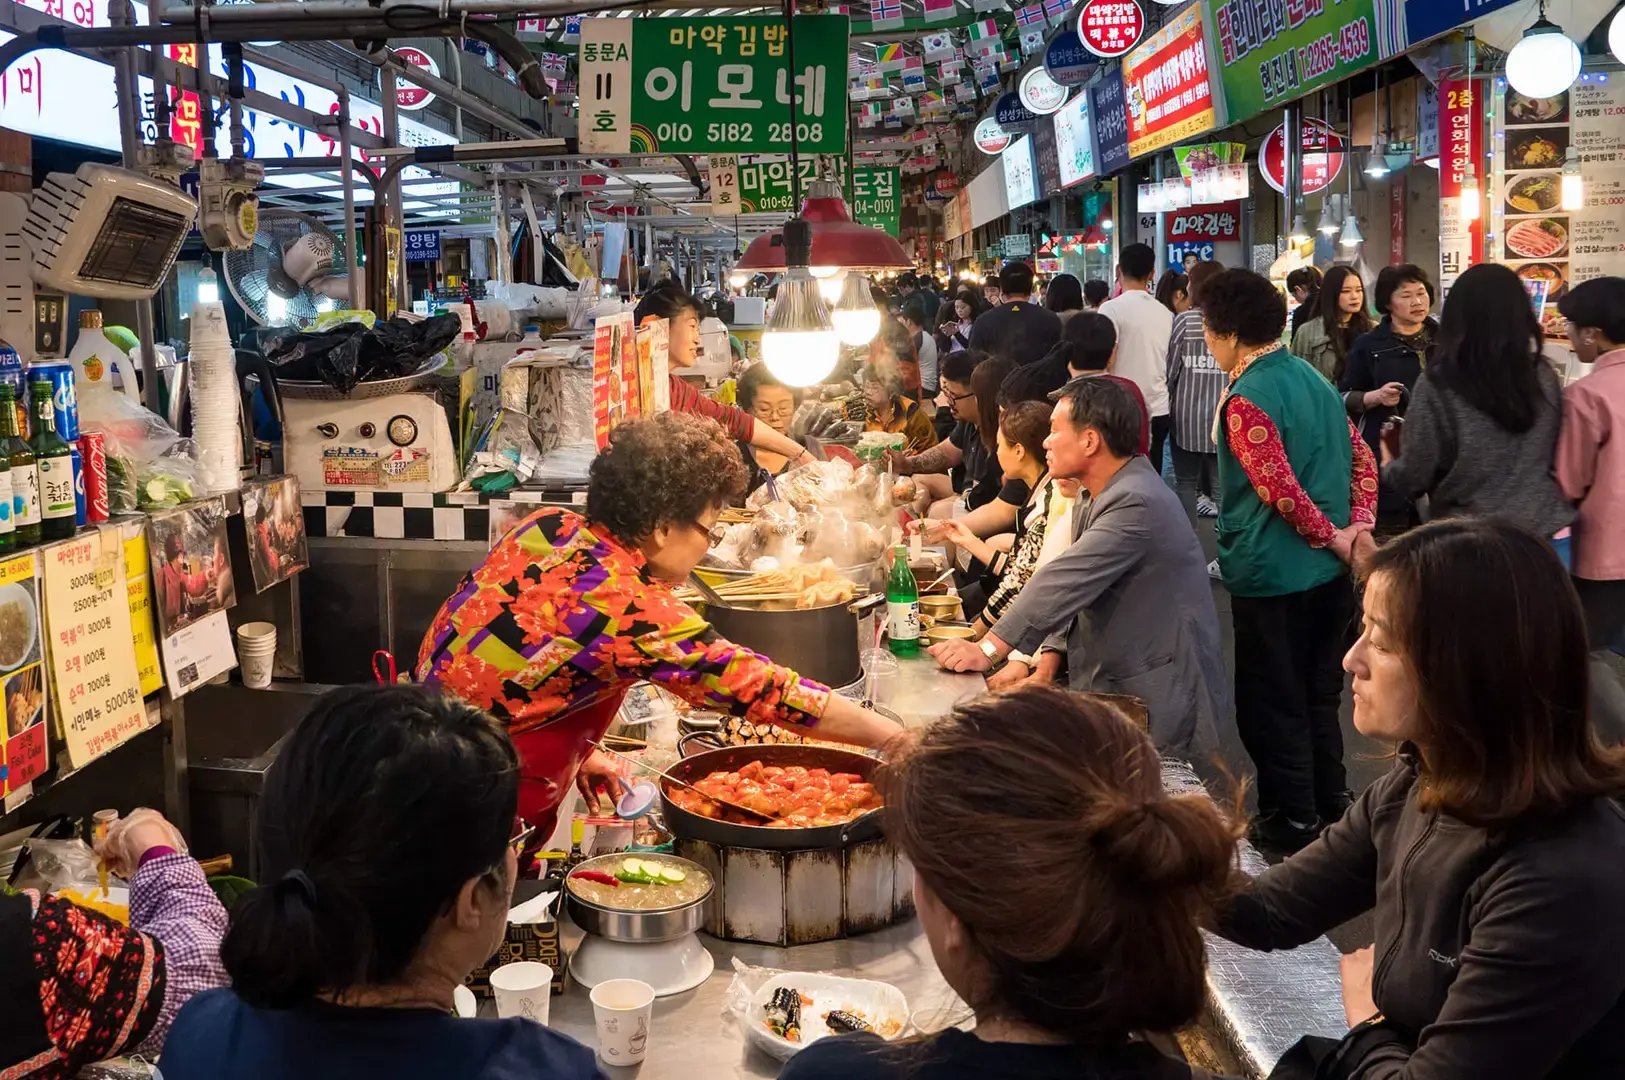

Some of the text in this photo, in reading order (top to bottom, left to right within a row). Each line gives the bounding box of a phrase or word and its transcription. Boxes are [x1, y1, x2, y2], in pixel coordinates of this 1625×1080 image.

[1089, 3, 1135, 17] 마약김밥
[670, 24, 788, 56] 마약김밥
[583, 42, 629, 62] 동문A
[1260, 48, 1299, 101] 현진네
[1299, 18, 1369, 81] T.2265-4539
[644, 60, 826, 117] 이모네
[1447, 89, 1475, 109] 2층
[592, 110, 617, 132] 호
[1575, 108, 1600, 118] 삼계탕
[657, 123, 823, 143] 010 5182 2808
[716, 173, 734, 187] 12
[719, 192, 732, 205] 호
[1171, 212, 1236, 236] 마약김밥
[57, 542, 91, 566] 마약김밥
[87, 615, 112, 635] 3000원
[83, 646, 106, 667] 1000원
[69, 673, 112, 705] 순대 7000원
